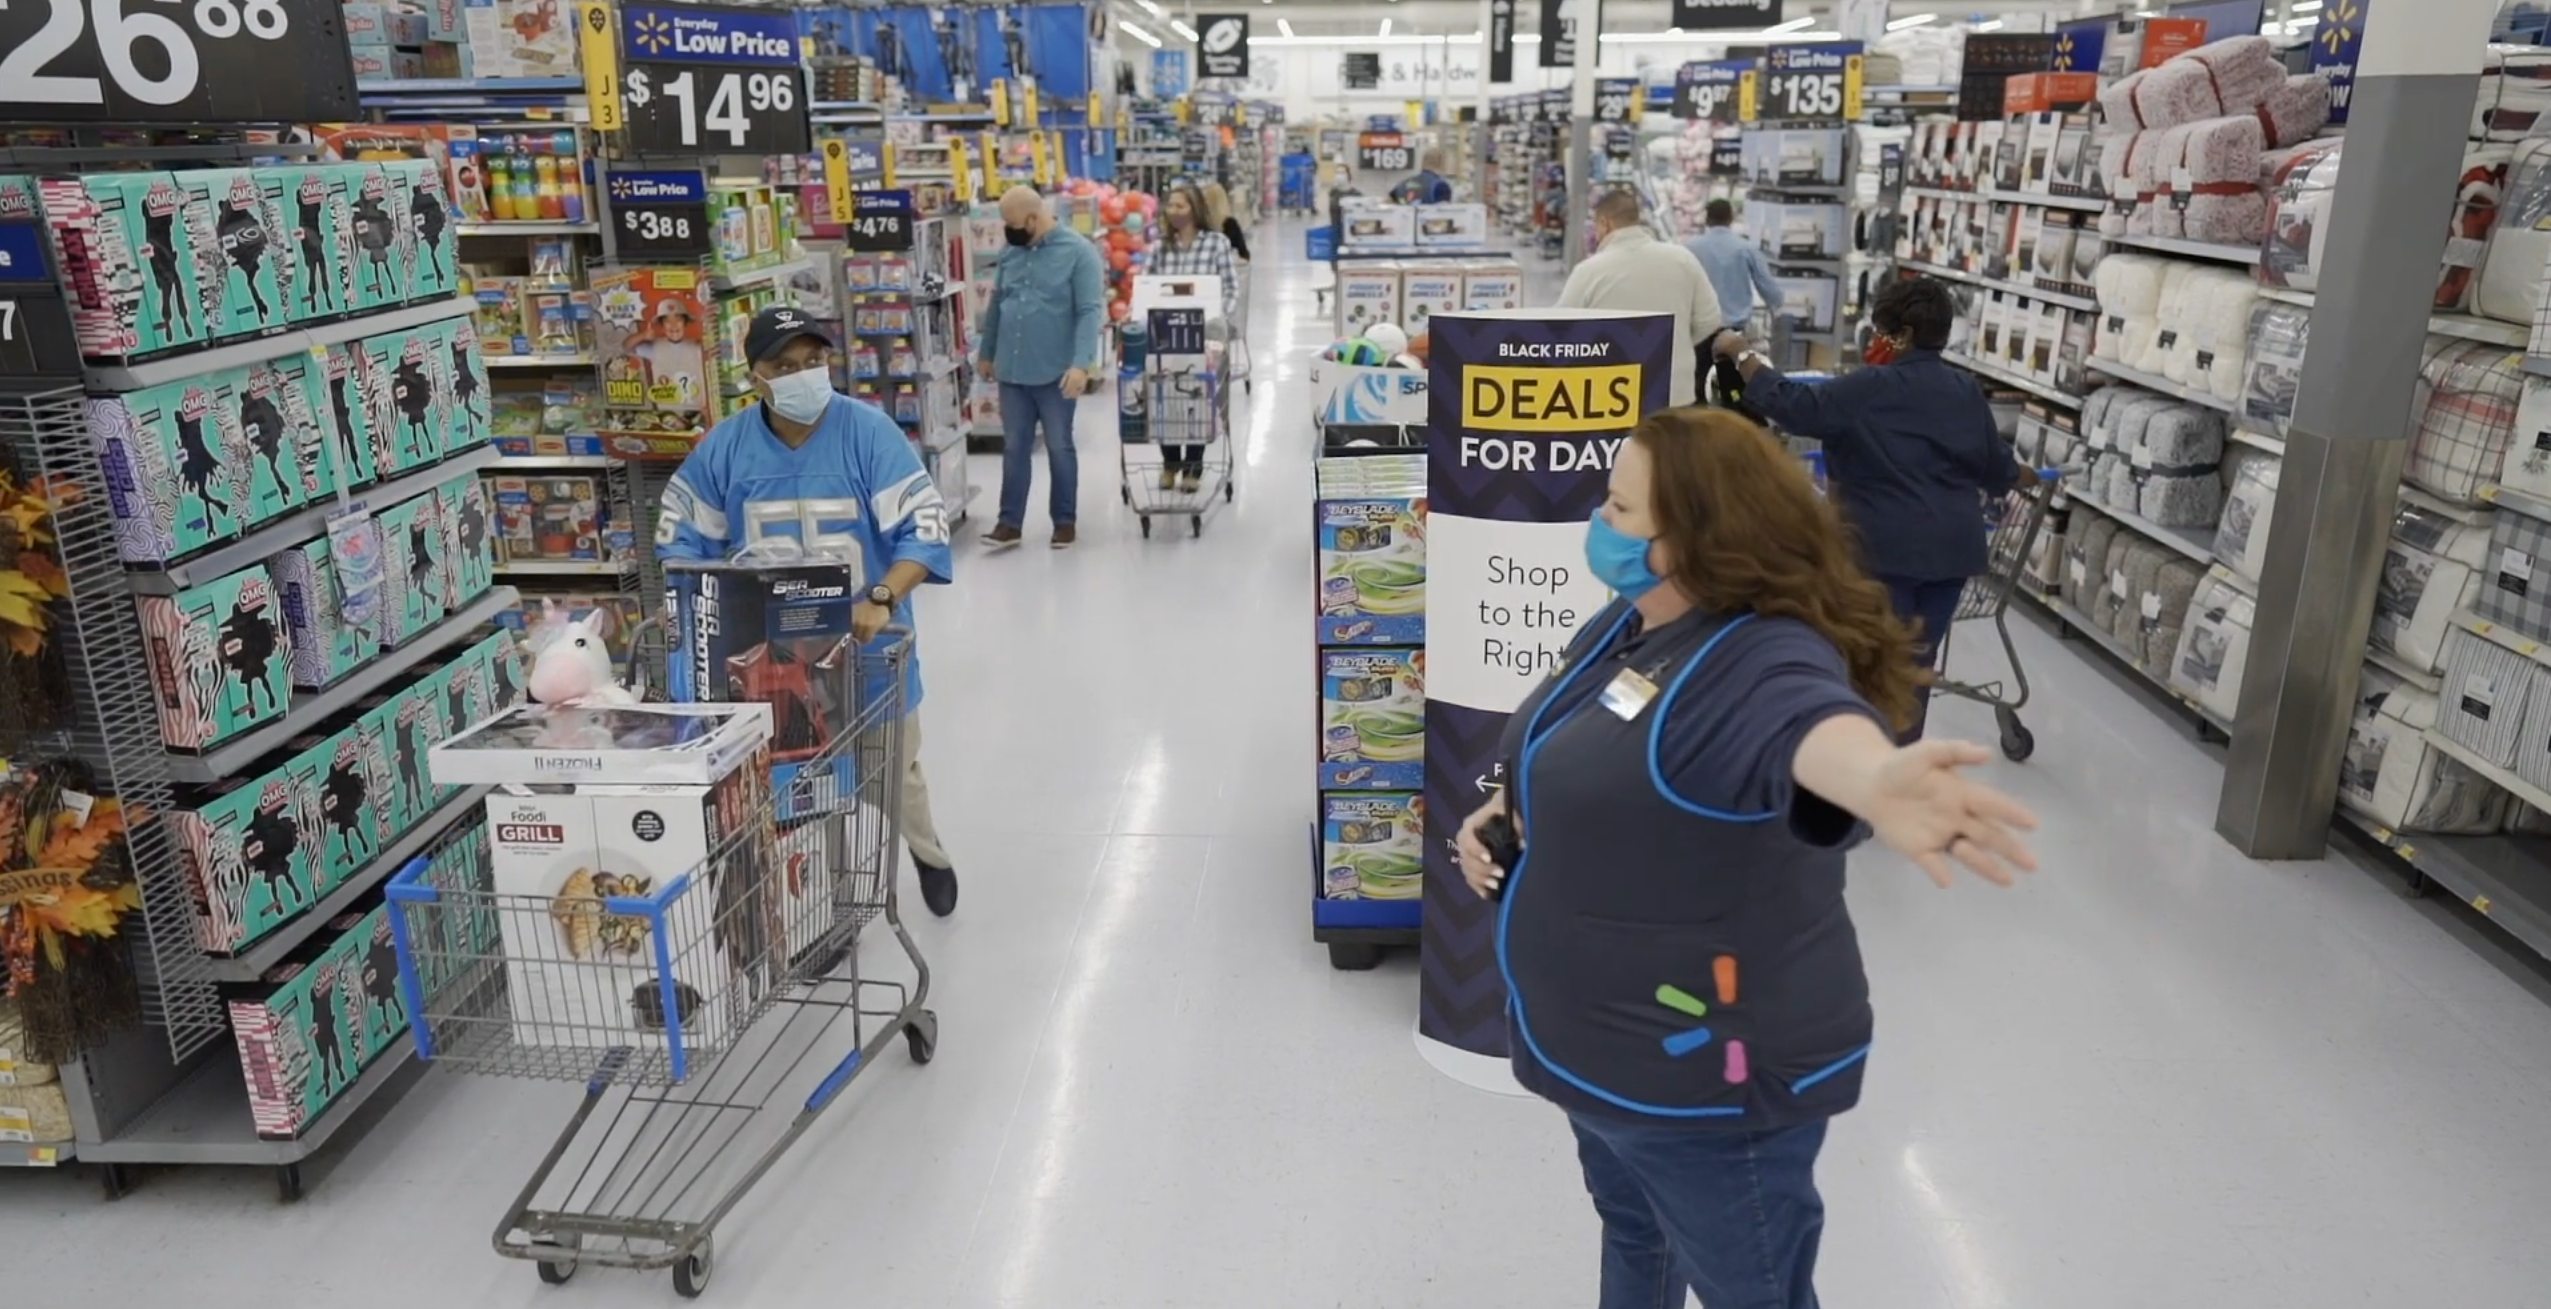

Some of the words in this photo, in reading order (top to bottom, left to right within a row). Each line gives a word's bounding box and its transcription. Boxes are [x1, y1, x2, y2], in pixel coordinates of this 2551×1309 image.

[674, 17, 719, 32] Everyday
[674, 29, 728, 54] Low
[731, 31, 790, 57] Price
[1789, 54, 1812, 68] Low
[1813, 53, 1842, 67] Price
[602, 75, 611, 96] J
[603, 105, 613, 124] 3
[231, 186, 255, 203] OMG
[301, 181, 326, 199] OMG
[363, 178, 386, 196] OMG
[632, 185, 659, 197] Low
[659, 183, 689, 195] Price
[0, 195, 28, 211] OMG
[149, 191, 176, 208] OMG
[1499, 343, 1551, 358] BLACK
[1555, 343, 1610, 358] FRIDAY
[249, 373, 270, 390] OMG
[606, 382, 642, 397] DINO
[182, 394, 207, 414] OMG
[1472, 376, 1631, 421] DEALS
[1461, 437, 1536, 472] FOR
[1550, 437, 1629, 473] DAY
[1331, 504, 1398, 516] BEYBLADE
[914, 507, 950, 546] 55
[1488, 555, 1569, 593] Shop
[240, 583, 268, 604] OMG
[773, 580, 808, 594] SEA
[785, 586, 844, 601] SCOOTER
[702, 573, 721, 637] SEA
[1479, 601, 1511, 627] to
[1523, 602, 1576, 629] the
[691, 593, 711, 701] SCOOTER
[1331, 655, 1398, 667] BEYBLADE
[1484, 639, 1565, 676] Right
[335, 743, 357, 762] OMG
[260, 784, 289, 808] OMG
[511, 811, 547, 822] Foodi
[501, 825, 561, 842] GRILL
[314, 967, 337, 989] OMG
